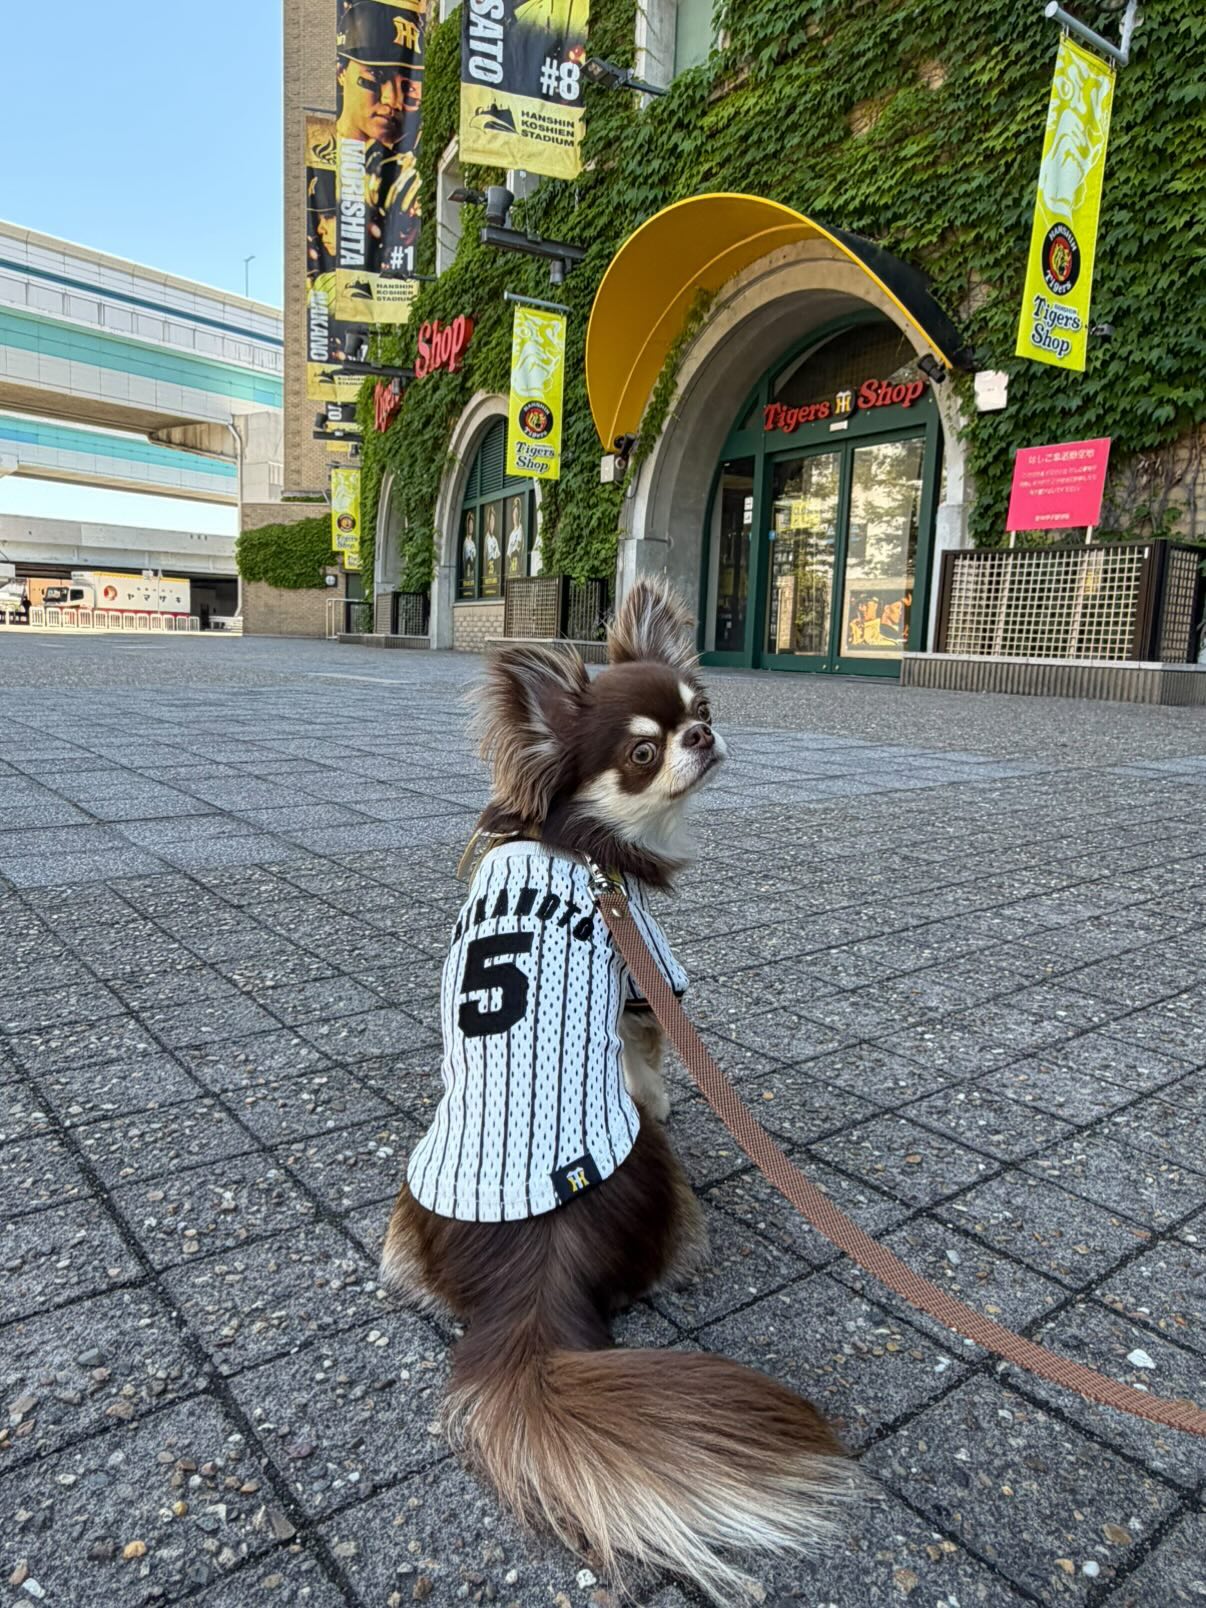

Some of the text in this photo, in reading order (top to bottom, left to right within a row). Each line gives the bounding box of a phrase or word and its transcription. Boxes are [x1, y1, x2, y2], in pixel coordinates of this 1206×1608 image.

[469, 0, 504, 84] SATO
[540, 57, 580, 100] #8
[521, 110, 575, 128] HANSHIN
[521, 120, 575, 138] KOSHIEN
[521, 129, 575, 147] STADIUM
[340, 138, 366, 266] MORISHITA
[1049, 225, 1077, 252] HANSHIN
[390, 246, 414, 271] #1
[310, 290, 329, 362] NAKANO
[1033, 295, 1081, 329] Tigers
[415, 313, 466, 379] Shop
[1031, 322, 1070, 356] Shop
[763, 401, 830, 433] Tigers
[857, 379, 924, 408] Shop
[516, 441, 555, 457] Tigers
[516, 456, 549, 472] Shop
[458, 932, 534, 1038] 5
